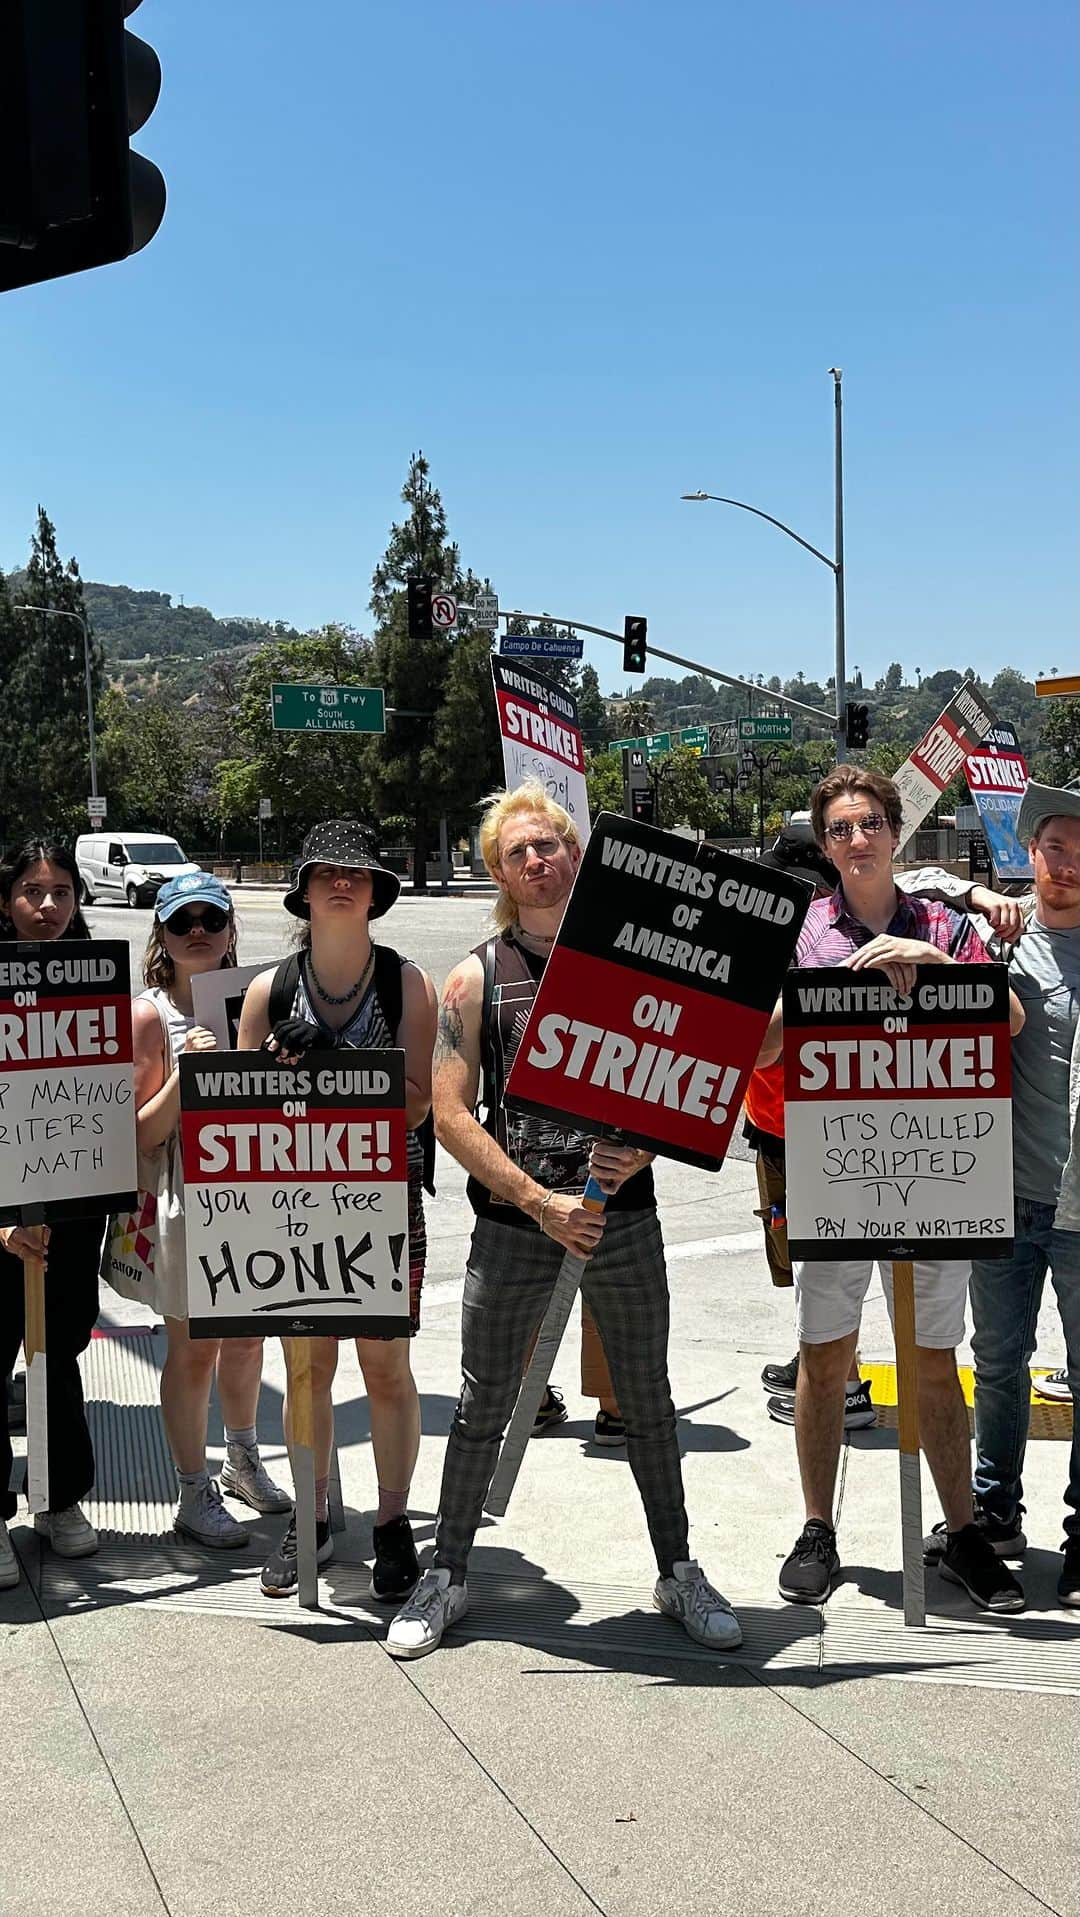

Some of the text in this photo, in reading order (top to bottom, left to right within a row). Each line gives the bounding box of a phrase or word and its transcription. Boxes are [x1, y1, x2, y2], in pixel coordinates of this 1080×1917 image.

[503, 640, 581, 654] Campo De Cahuenga
[302, 691, 366, 706] To 101 Fwy
[500, 668, 574, 719] WRITERS GUILD
[317, 708, 343, 718] SOUTH
[538, 702, 549, 715] ON
[305, 719, 356, 730] ALL LANES
[505, 702, 579, 766] STRIKE!
[757, 724, 782, 735] NORTH
[633, 754, 642, 766] M
[917, 725, 966, 784] STRIKE!
[967, 756, 1027, 789] STRIKE!
[600, 836, 795, 926] WRITERS GUILD
[672, 904, 703, 931] OF
[613, 922, 731, 984] AMERICA
[46, 958, 116, 984] GUILD
[14, 991, 37, 1007] ON
[798, 984, 994, 1013] WRITERS GUILD
[632, 994, 683, 1036] ON
[883, 1016, 908, 1034] ON
[0, 1005, 119, 1061] RIKE!
[527, 1013, 741, 1125] STRIKE!
[799, 1035, 996, 1091] STRIKE!
[31, 1076, 132, 1109] MAKING
[195, 1070, 391, 1097] WRITERS GUILD
[282, 1101, 307, 1117] ON
[0, 1113, 104, 1145] RITERS
[823, 1111, 994, 1142] IT'S CALLED
[198, 1120, 392, 1173] STRIKE!
[21, 1146, 104, 1183] MATH
[822, 1148, 977, 1177] SCRIPTED
[196, 1183, 383, 1227] you are free
[862, 1179, 916, 1206] TV
[275, 1214, 309, 1237] to
[815, 1217, 1007, 1238] PAY YOUR WRITERS
[112, 1259, 143, 1283] anon
[198, 1231, 406, 1307] HONK!
[846, 1394, 868, 1407] OKA
